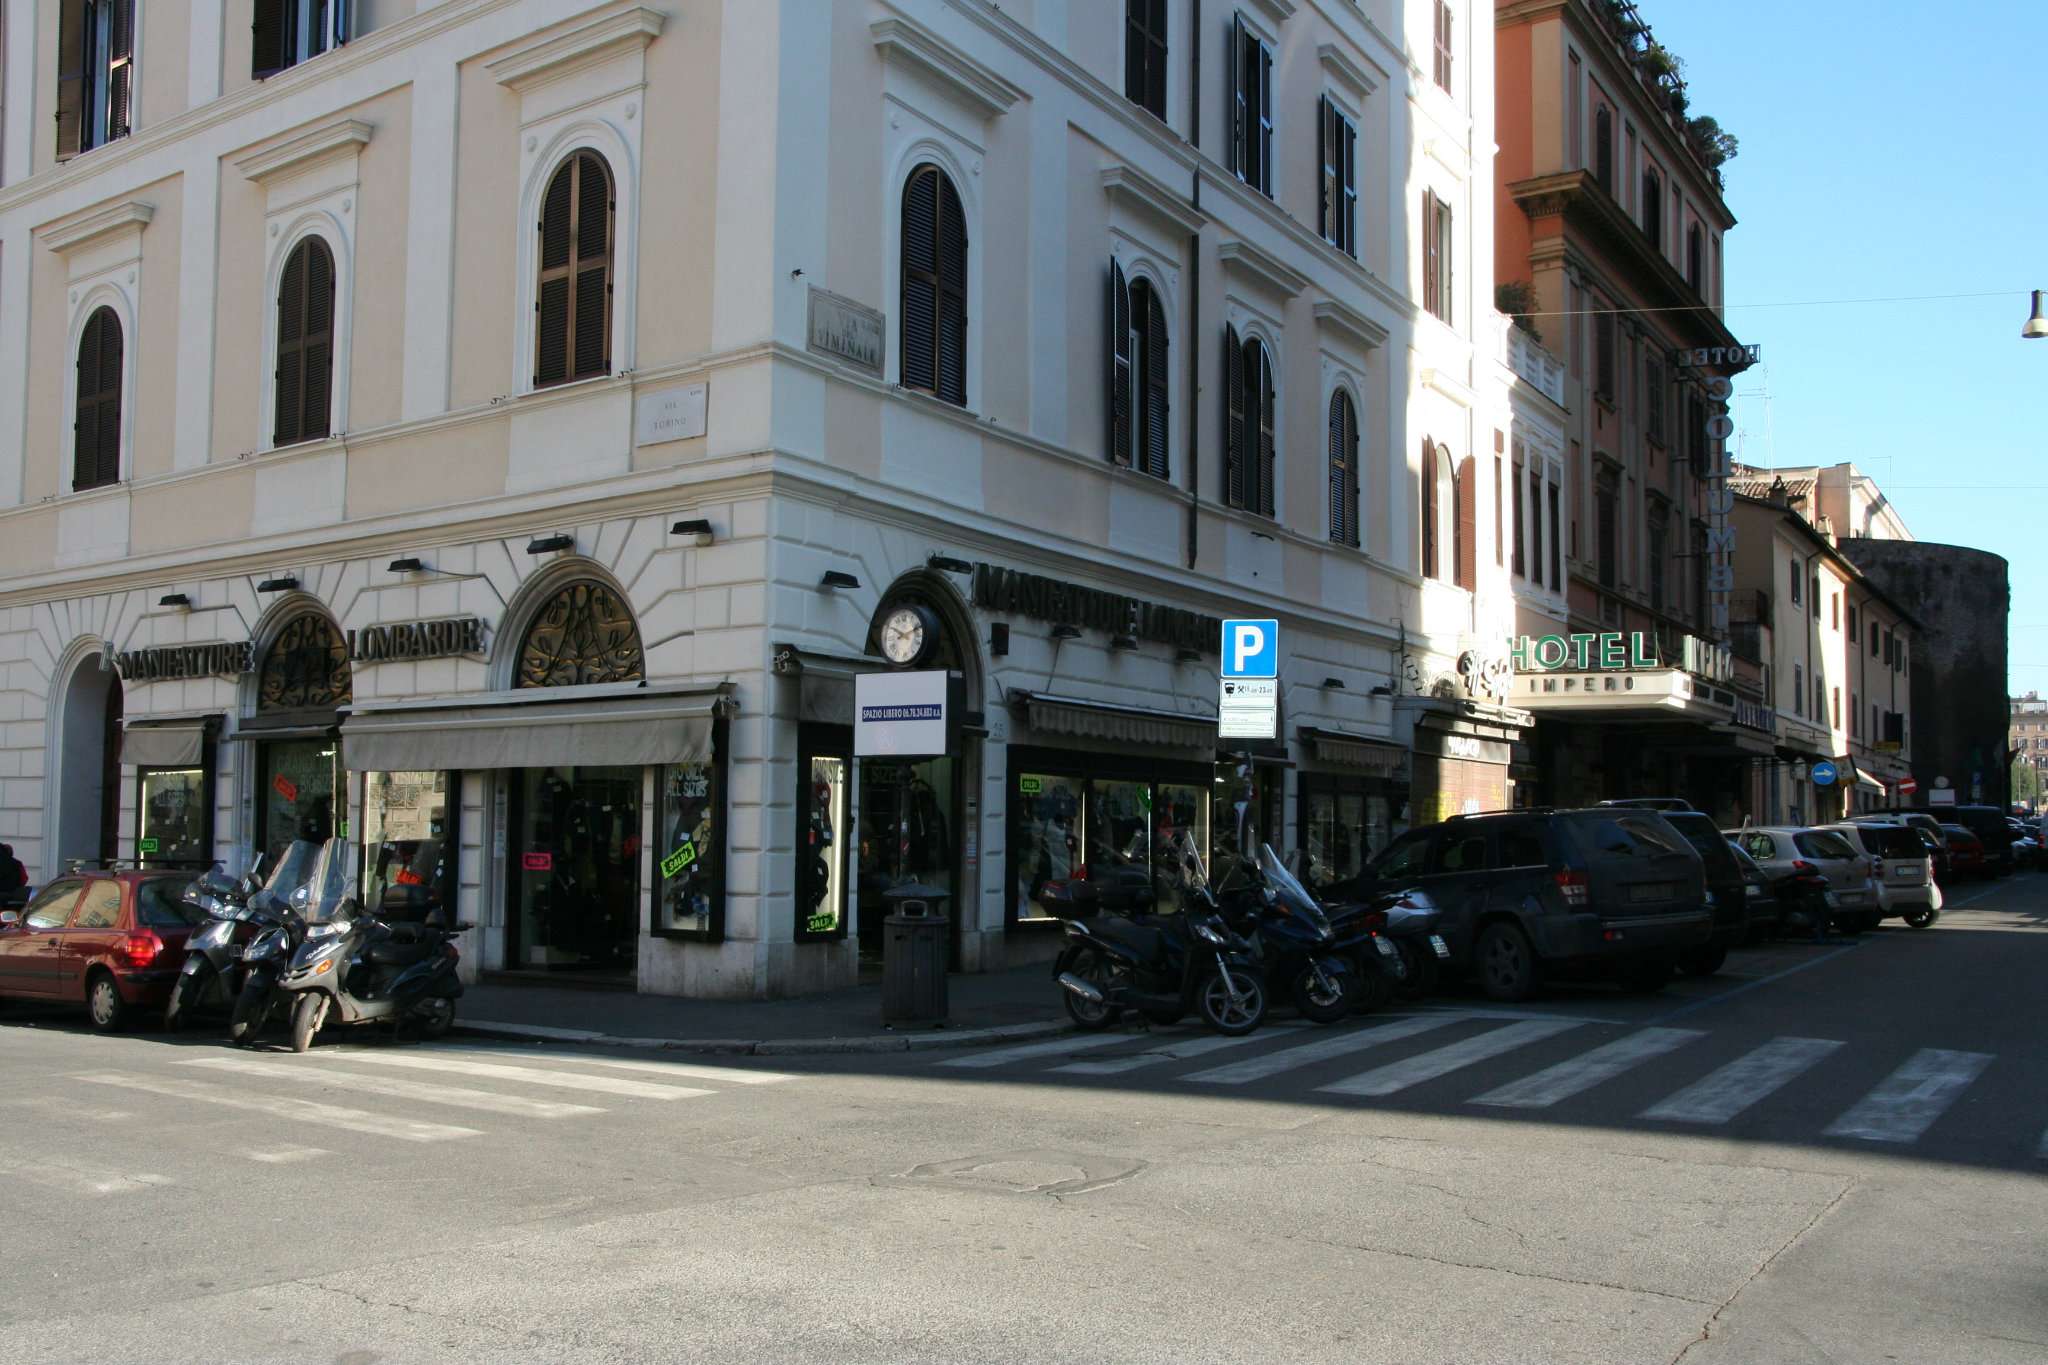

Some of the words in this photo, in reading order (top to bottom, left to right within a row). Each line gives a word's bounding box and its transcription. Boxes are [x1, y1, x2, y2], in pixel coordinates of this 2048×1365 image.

[653, 416, 687, 431] TORINO
[122, 640, 256, 681] MANIFATTURE
[346, 617, 488, 662] LOMBARDE
[1234, 625, 1264, 672] P
[1507, 631, 1658, 671] HOTEL
[1530, 676, 1634, 693] IMPERO
[863, 709, 882, 719] SPAZIO
[883, 708, 902, 719] LIBERO
[682, 780, 707, 798] SIZES
[667, 851, 690, 870] SALDI
[809, 916, 831, 930] SALDI
